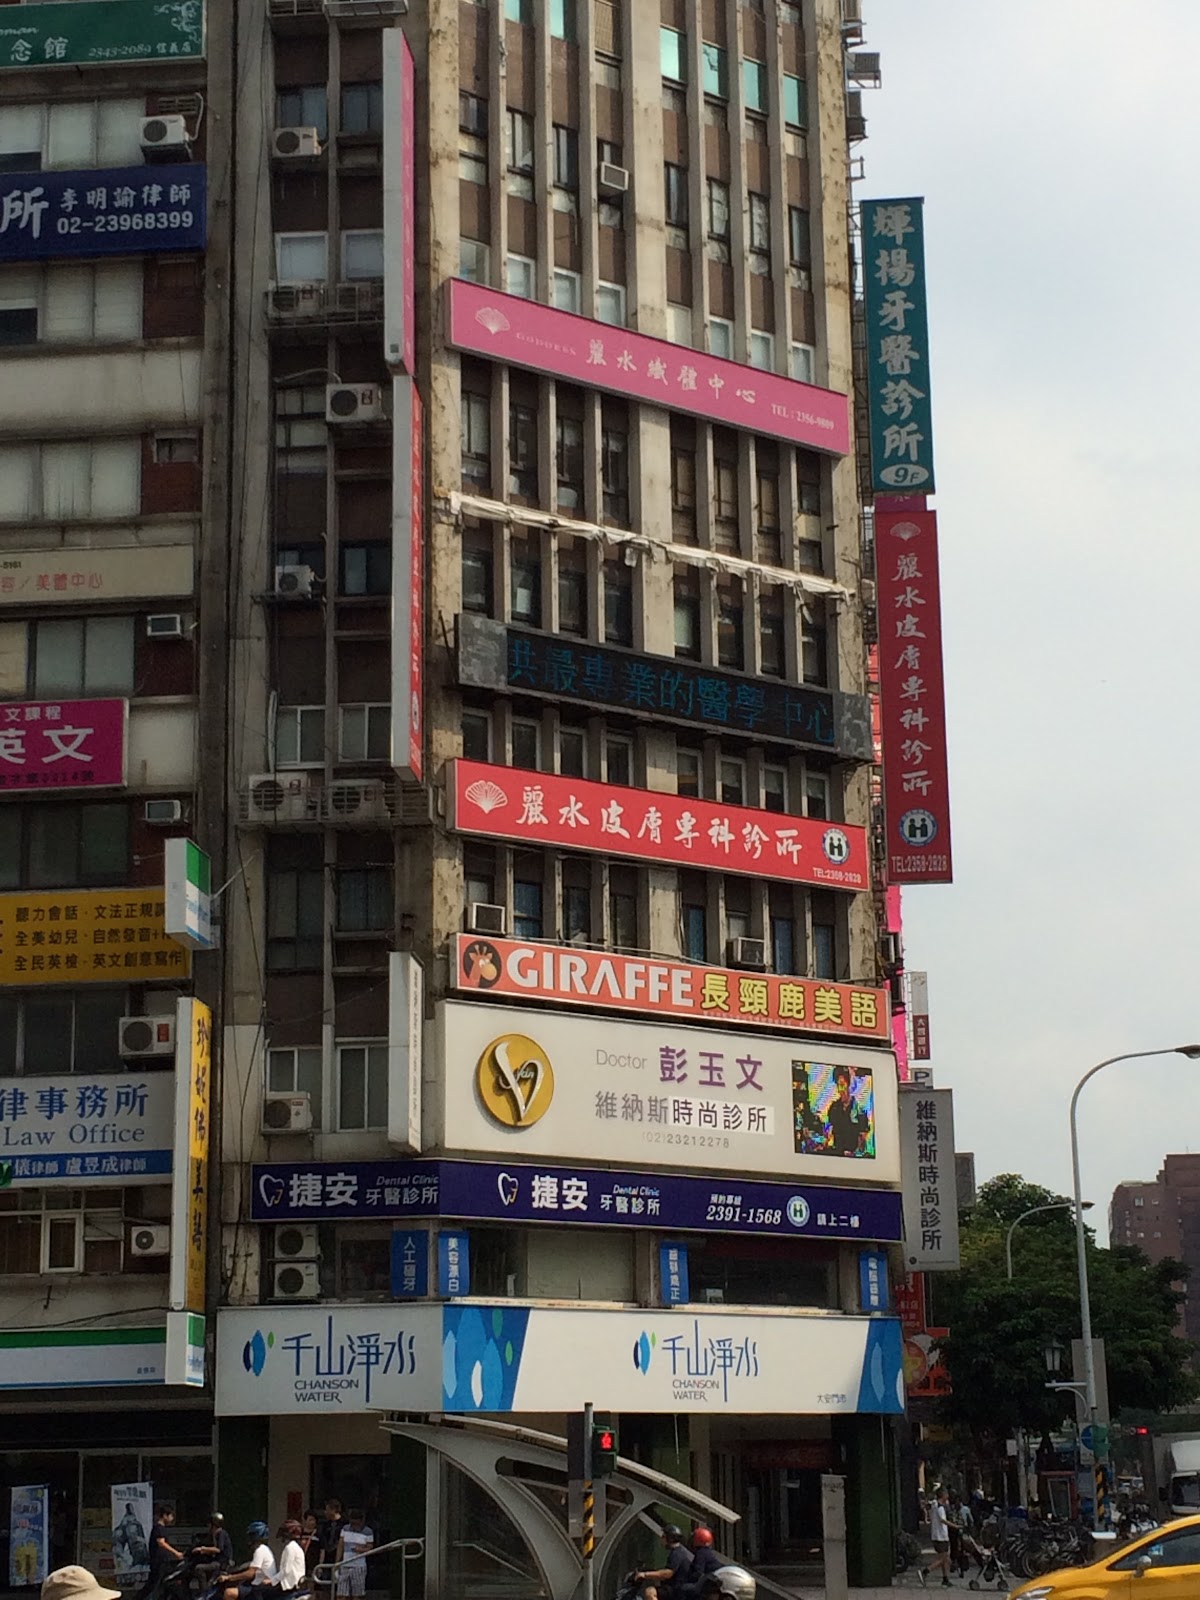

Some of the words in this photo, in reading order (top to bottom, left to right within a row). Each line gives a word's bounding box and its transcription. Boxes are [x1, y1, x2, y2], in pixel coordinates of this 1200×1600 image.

[11, 36, 68, 61] 念館
[60, 183, 191, 212] 李明諭律師
[57, 211, 193, 234] 02-23968399
[894, 467, 920, 484] 9F
[891, 554, 932, 797] 麗水皮膚專科診所
[515, 785, 804, 865] 麗水皮膚專科診所
[506, 948, 693, 1007] GIRAFFE
[700, 973, 878, 1028] 長頸鹿美語
[597, 1049, 648, 1070] Doctor
[659, 1046, 763, 1092] 彭玉文
[0, 1083, 149, 1122] 律事務所
[594, 1091, 767, 1133] 維納斯時尚診所
[4, 1127, 55, 1146] Law
[69, 1123, 145, 1145] Office
[376, 1175, 409, 1186] Dental
[412, 1174, 439, 1184] Clinic
[916, 1099, 942, 1250] 維納斯時尚診所
[289, 1172, 358, 1207] 捷安
[366, 1186, 438, 1206] 牙醫診所
[531, 1174, 588, 1212] 捷安
[613, 1184, 638, 1195] Dental
[639, 1185, 660, 1197] Clinic
[600, 1194, 660, 1216] 牙醫診所
[706, 1205, 782, 1225] 2391-1568
[282, 1315, 416, 1403] 千山淨水
[662, 1320, 758, 1402] 千山淨水
[295, 1379, 359, 1389] CHANSON
[672, 1379, 720, 1390] CHANSON
[672, 1391, 707, 1402] WATER
[295, 1391, 342, 1403] WATER
